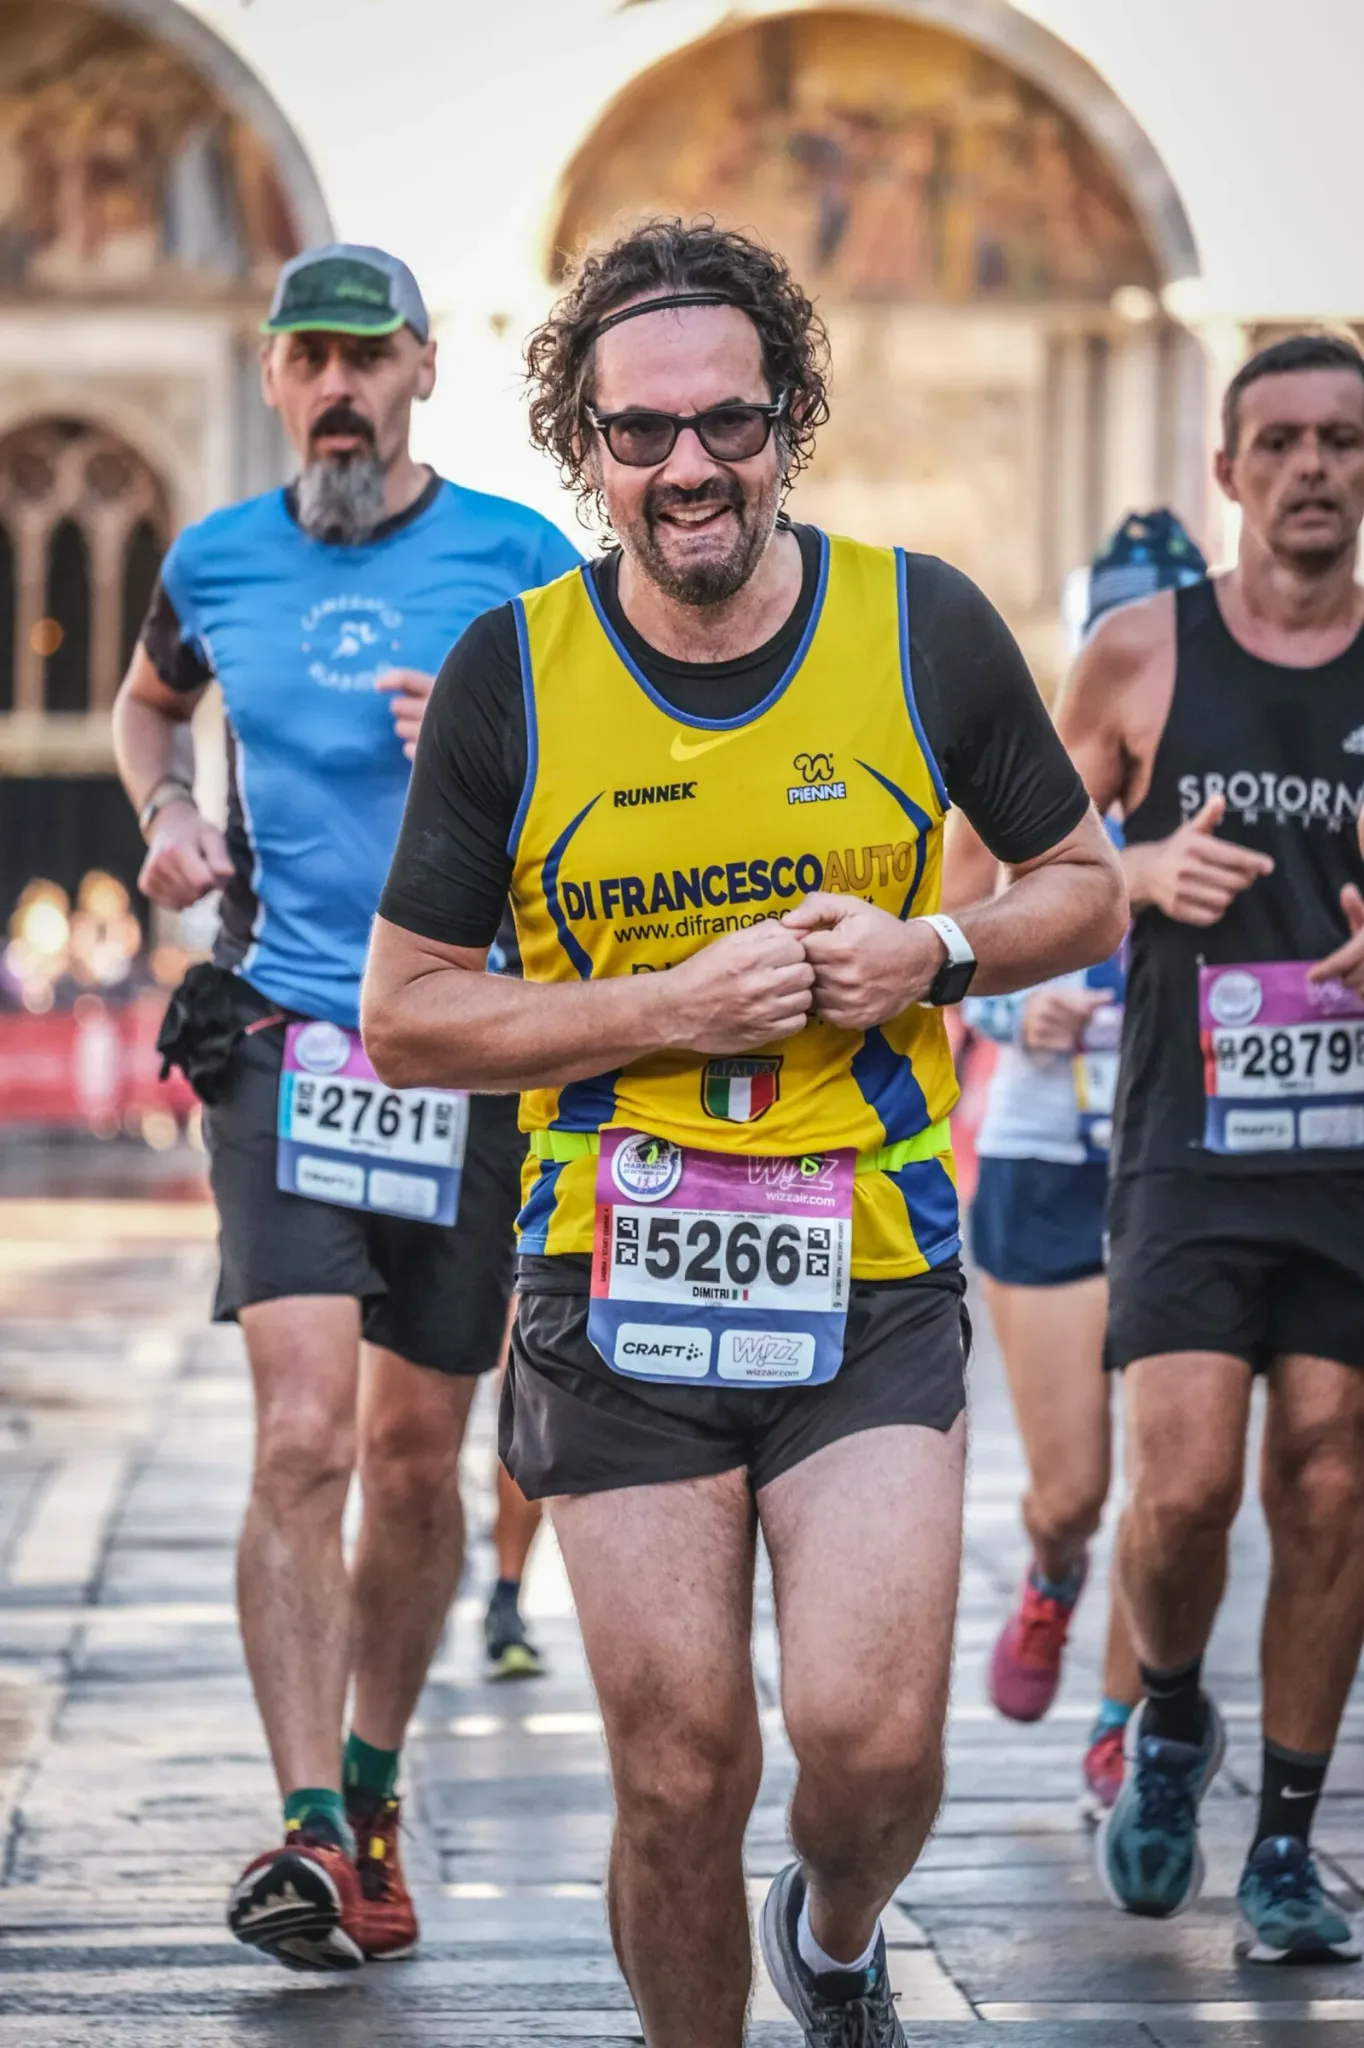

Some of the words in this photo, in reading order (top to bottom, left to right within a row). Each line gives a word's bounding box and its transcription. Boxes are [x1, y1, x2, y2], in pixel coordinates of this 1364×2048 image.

[614, 781, 698, 808] RUNNEK
[787, 782, 847, 805] PIENNE
[1178, 771, 1364, 819] SPOTORN
[561, 881, 597, 921] DI
[1241, 1030, 1351, 1078] 2879
[317, 1086, 428, 1145] 2761
[765, 1191, 836, 1207] wizzair.com
[644, 1217, 801, 1286] 5266
[692, 1287, 730, 1299] DIMITRI
[622, 1342, 686, 1358] CRAFT
[746, 1368, 800, 1378] wizzair.com
